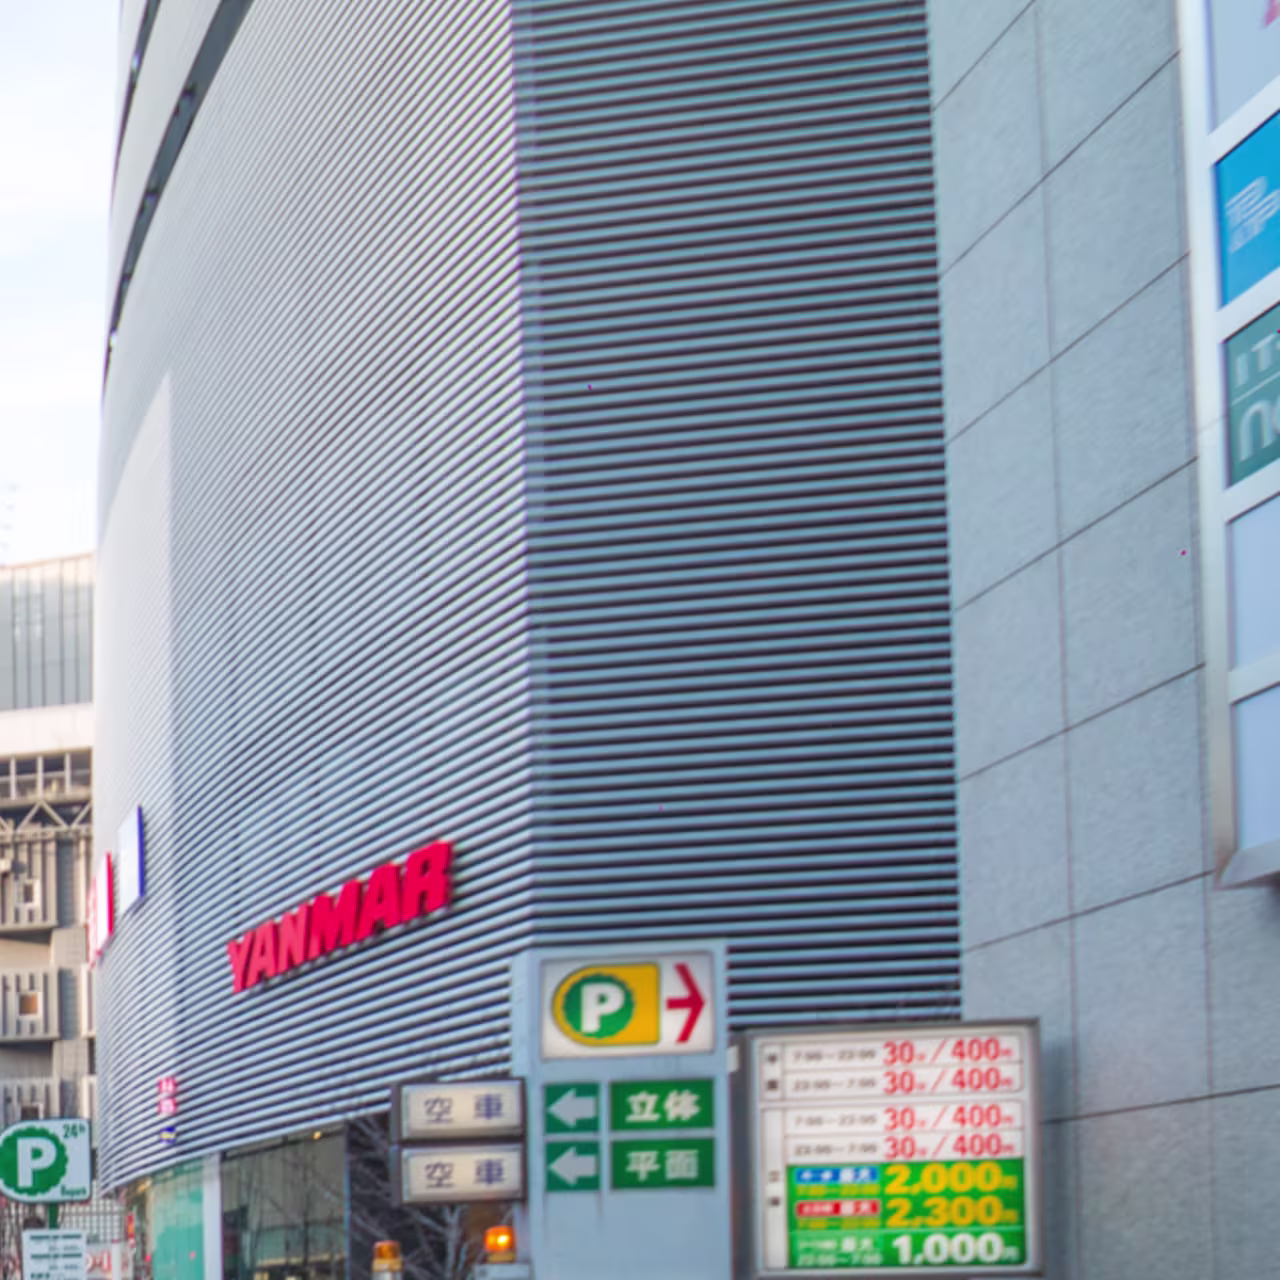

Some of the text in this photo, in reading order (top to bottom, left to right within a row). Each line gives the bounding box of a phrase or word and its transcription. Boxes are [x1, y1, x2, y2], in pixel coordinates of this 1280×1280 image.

[226, 839, 454, 995] YANMAR
[581, 982, 625, 1033] P
[424, 1093, 503, 1125] 空車
[626, 1090, 700, 1123] 立体
[17, 1137, 57, 1187] P
[424, 1160, 503, 1190] 空車
[625, 1149, 699, 1181] 平面
